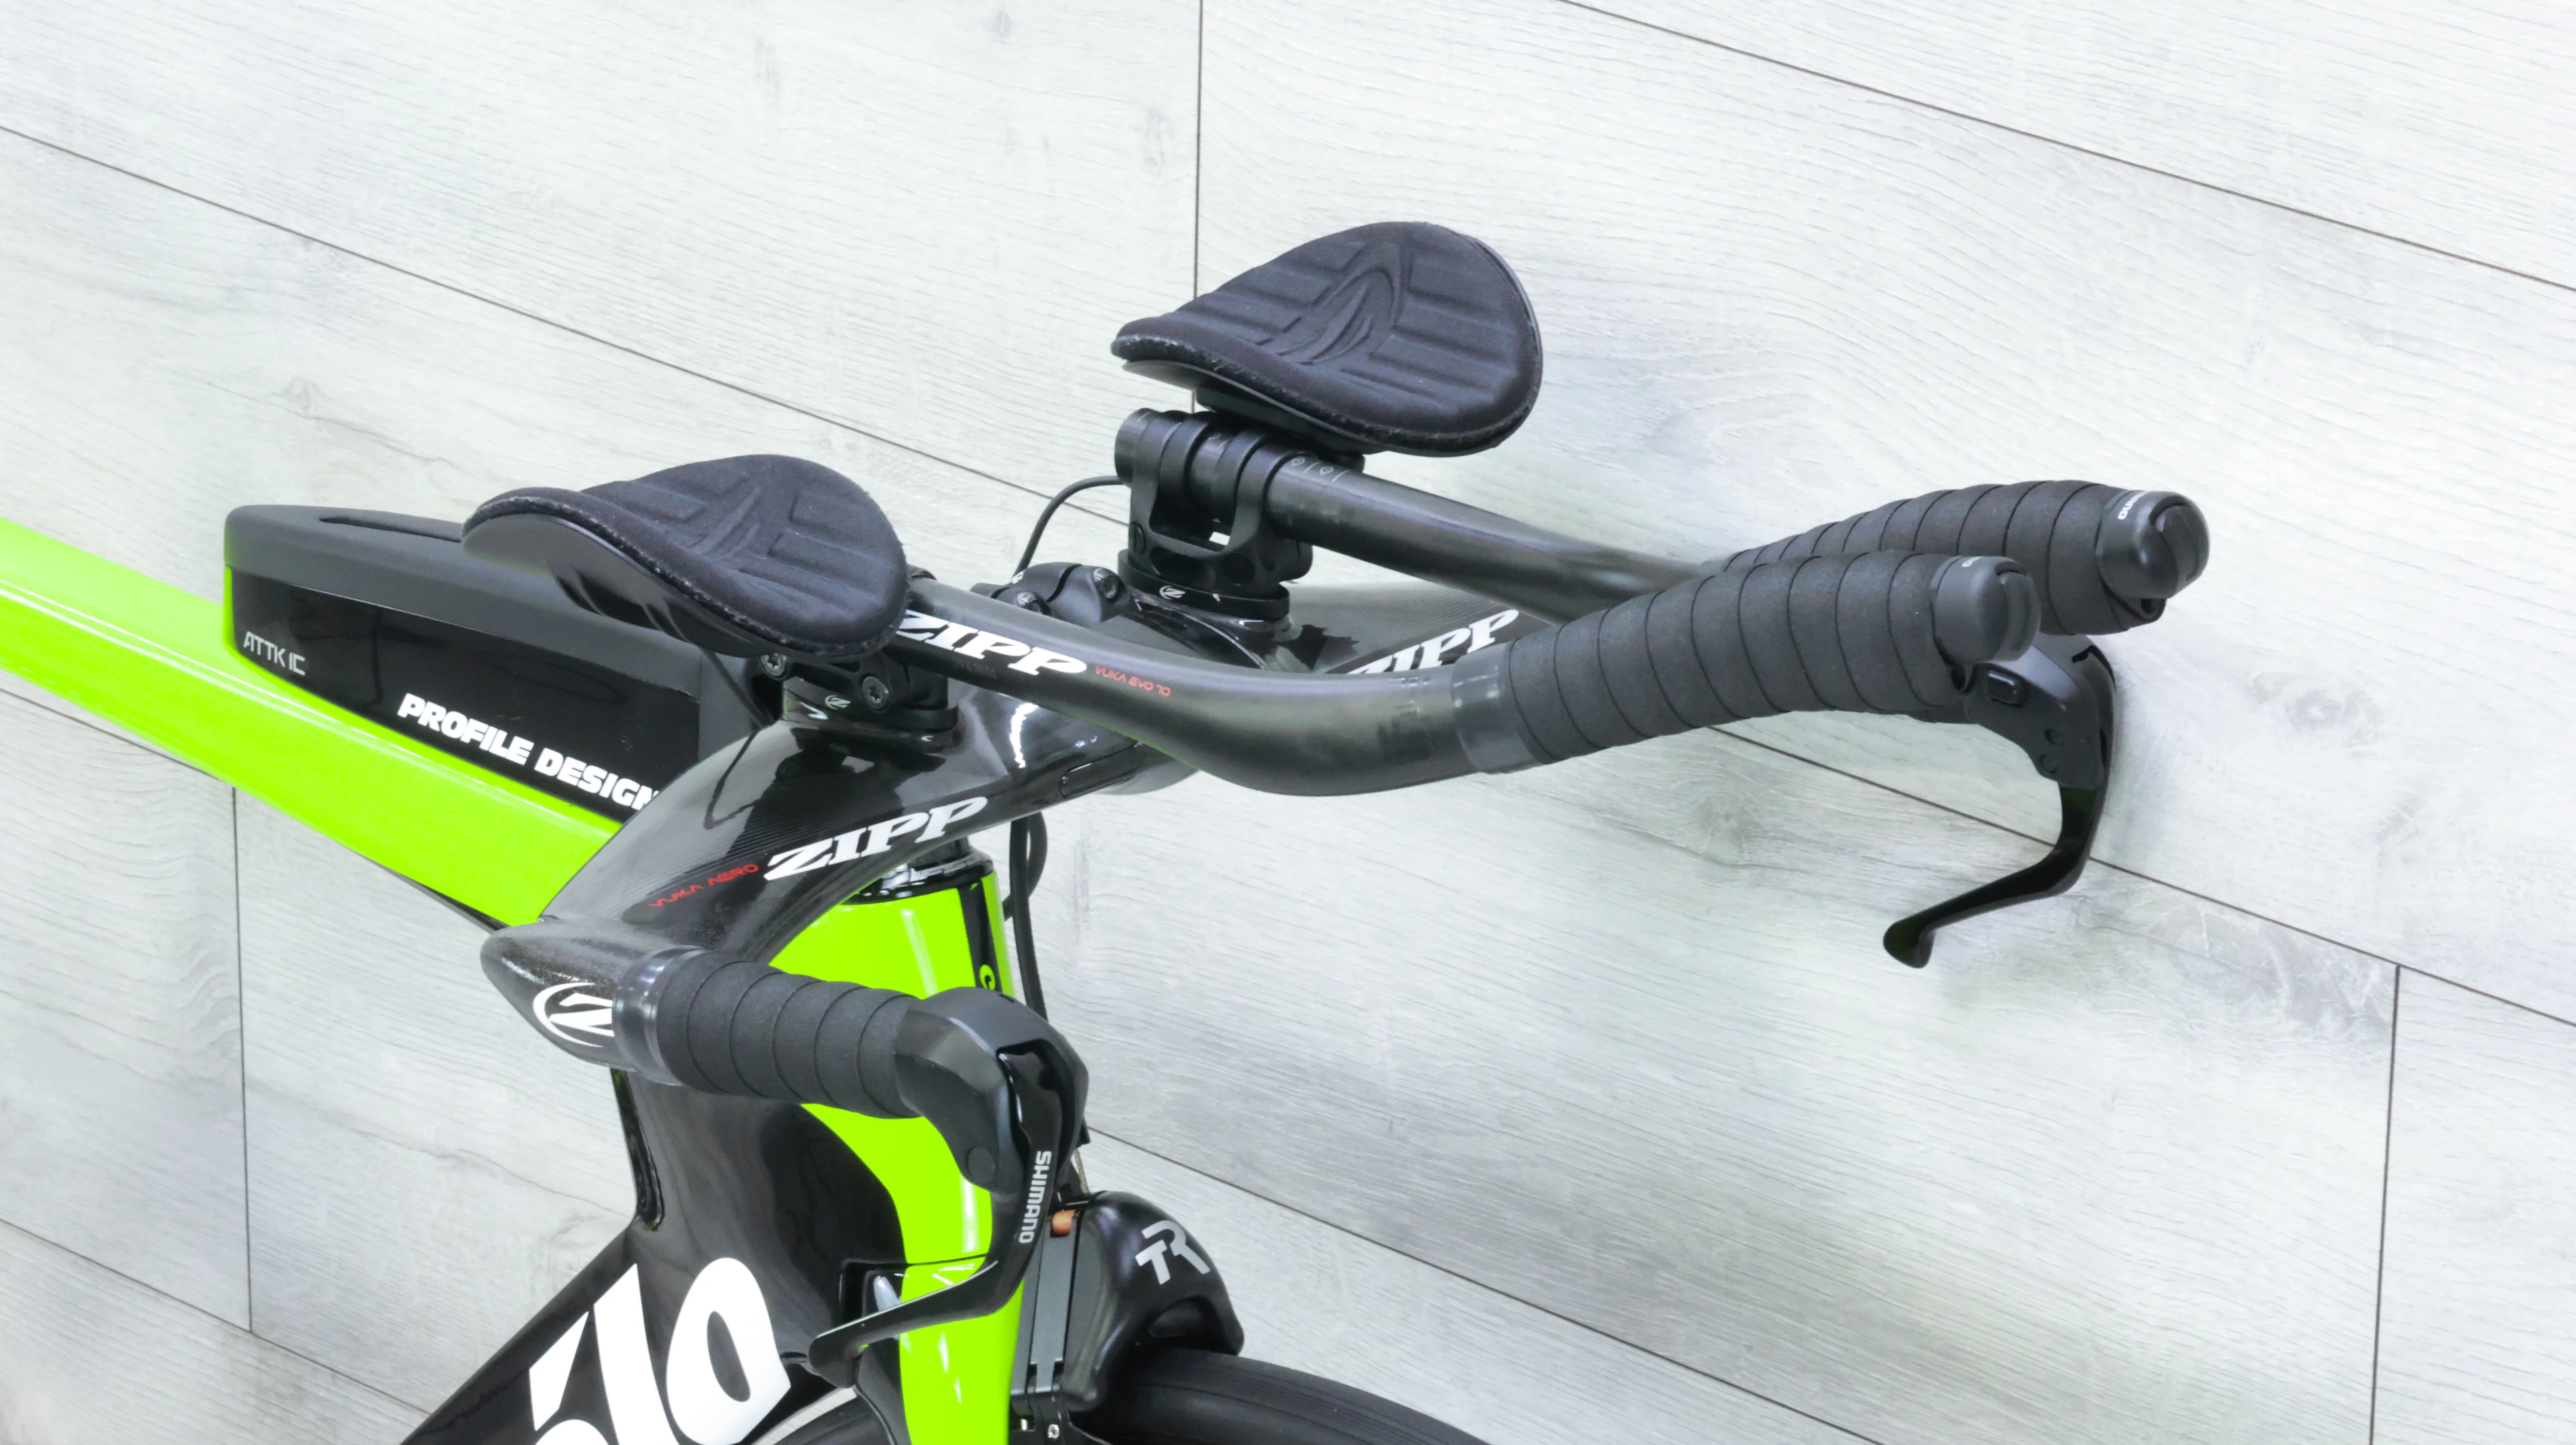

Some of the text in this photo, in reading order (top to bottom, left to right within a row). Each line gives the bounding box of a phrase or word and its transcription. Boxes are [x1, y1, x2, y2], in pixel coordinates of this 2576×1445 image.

[243, 631, 286, 668] ATTK
[896, 609, 1088, 676] ZIPP
[1095, 666, 1127, 683] VUKA
[1128, 676, 1154, 691] EVO
[397, 692, 535, 765] PROFILE
[763, 796, 988, 881] ZIPP
[648, 863, 759, 907] VUKA AERO
[1019, 1151, 1052, 1244] SHIMANO
